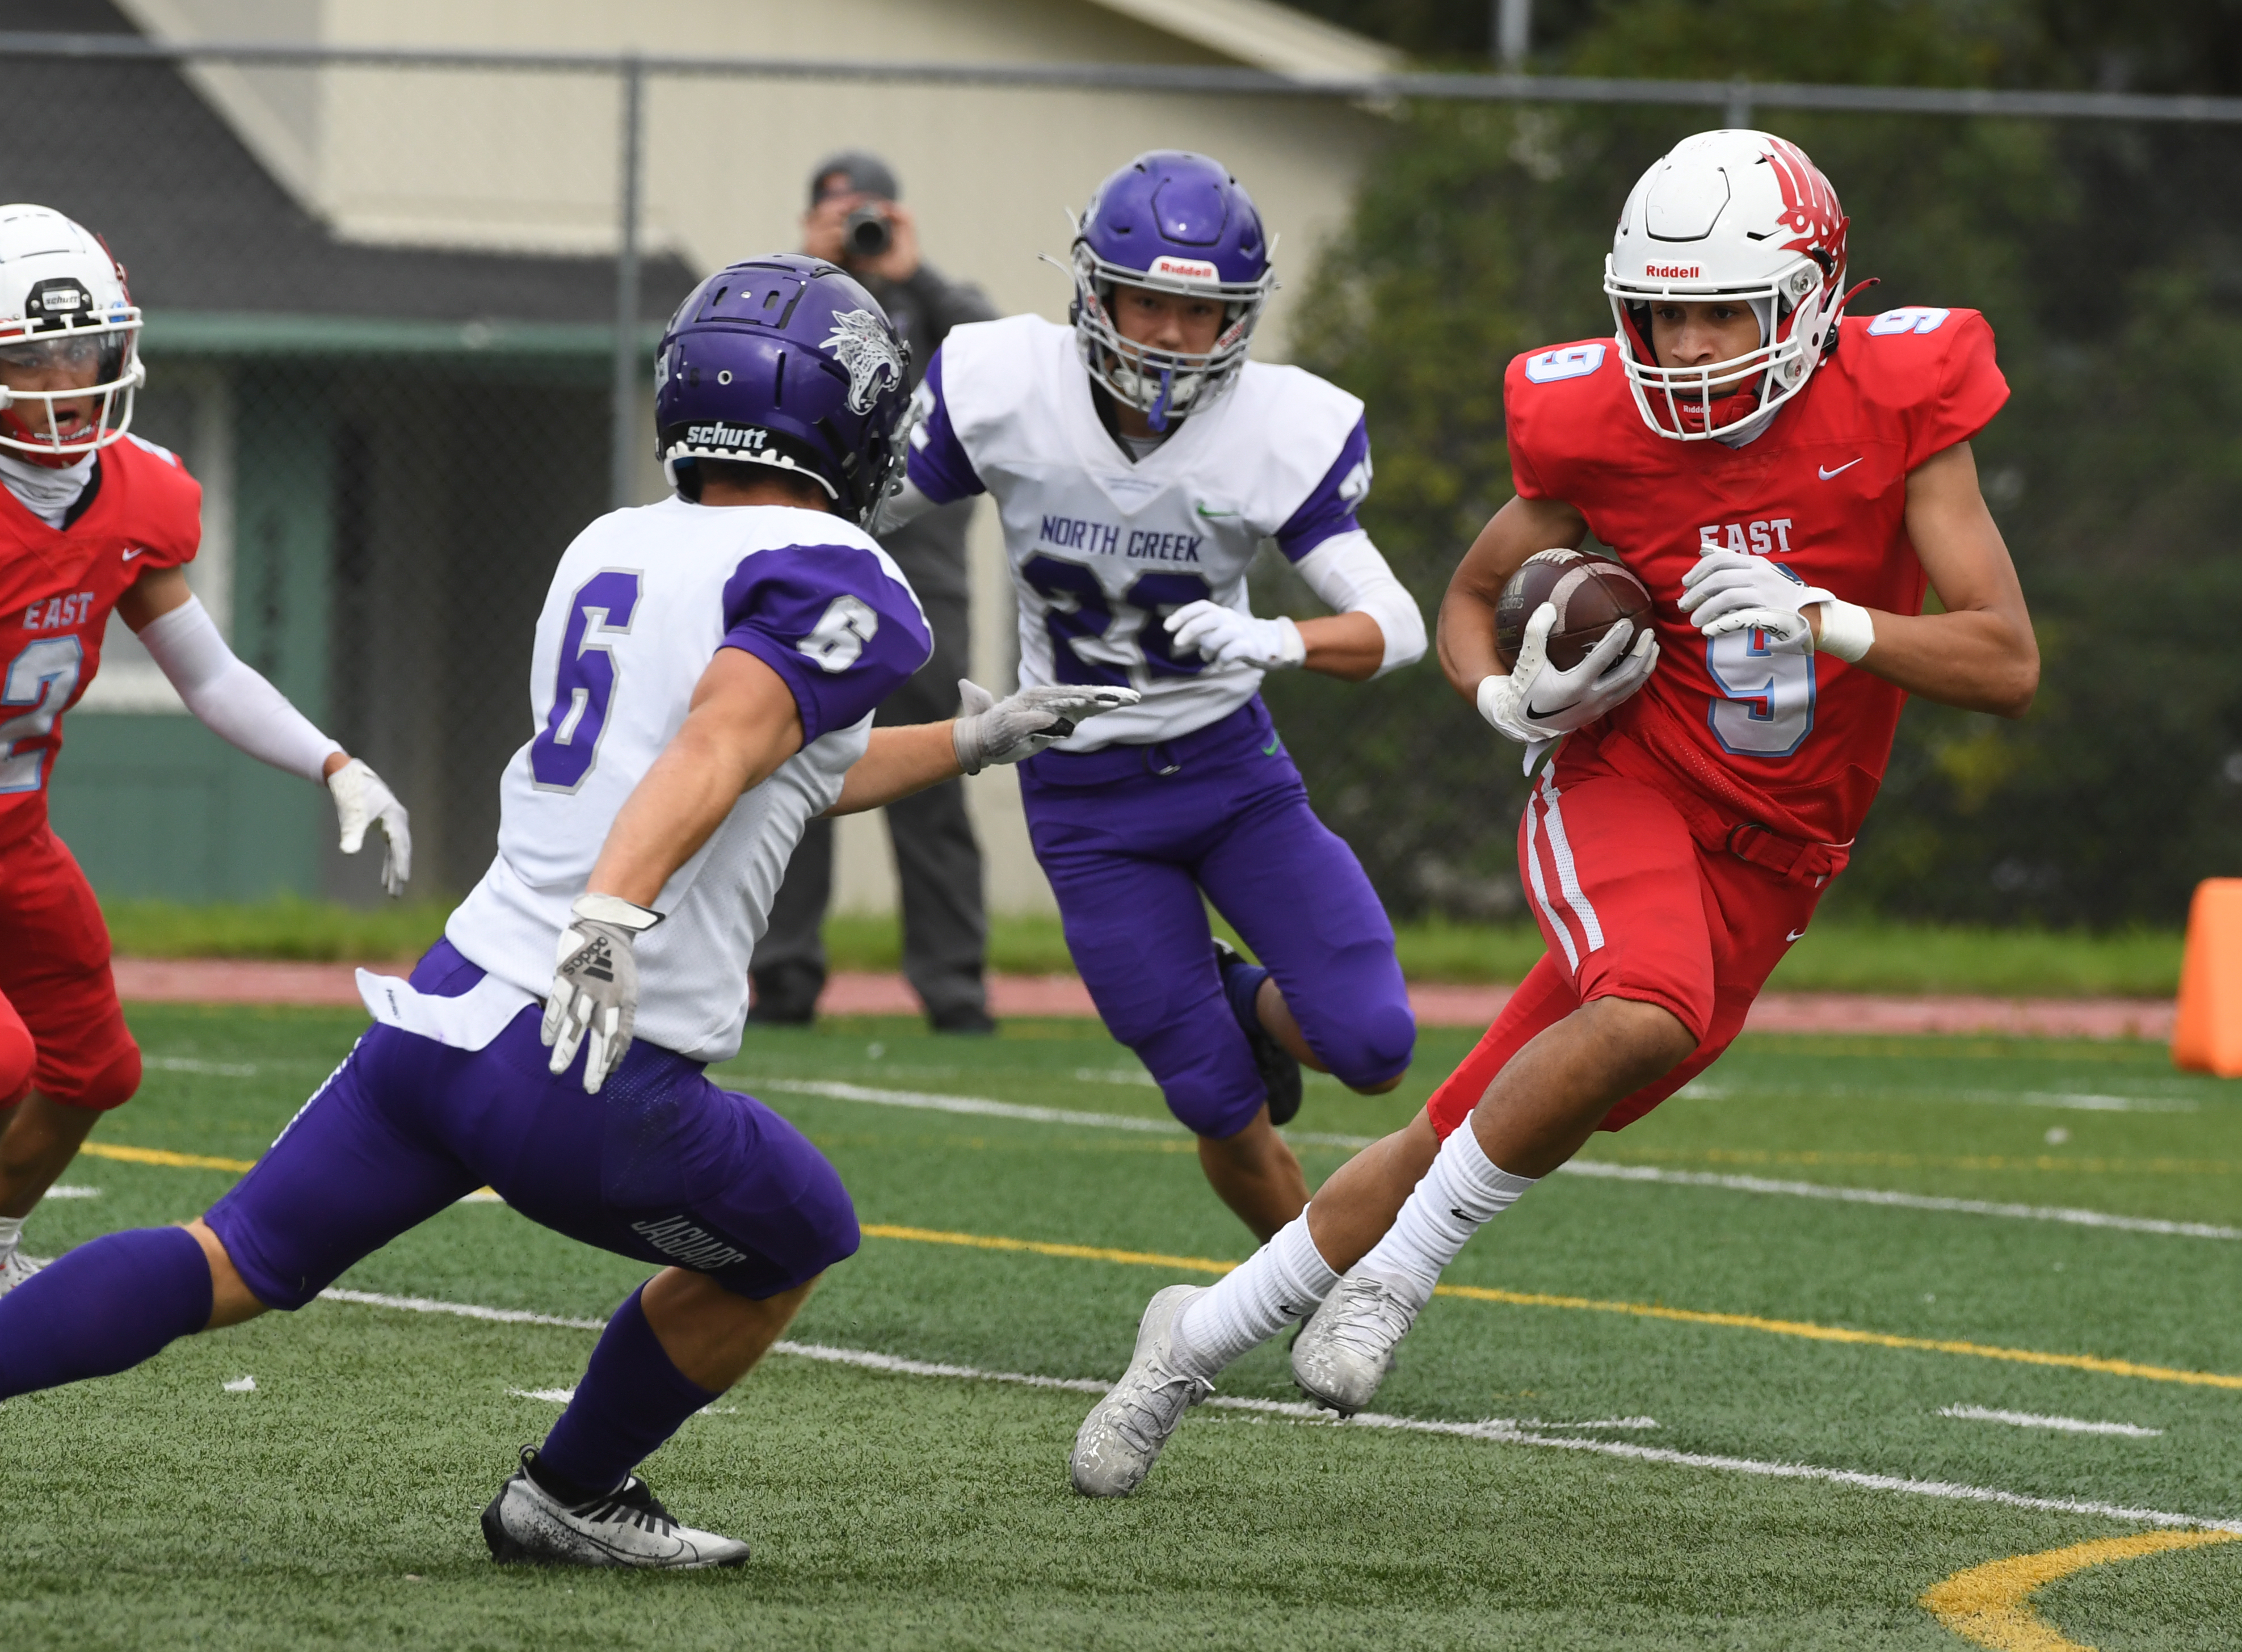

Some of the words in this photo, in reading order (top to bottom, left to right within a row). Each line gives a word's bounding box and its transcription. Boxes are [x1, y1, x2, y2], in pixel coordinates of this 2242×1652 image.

[1161, 263, 1212, 277] Riddell
[1646, 265, 1700, 278] Riddell
[45, 295, 79, 305] schutt
[1866, 307, 1950, 337] 9
[1525, 343, 1606, 384] 9
[687, 422, 768, 449] schutt
[1039, 515, 1120, 556] NORTH
[1127, 531, 1202, 562] CREEK
[1699, 518, 1793, 556] EAST
[22, 592, 94, 630] EAST
[797, 594, 878, 674] 6
[1706, 562, 1816, 758] 9
[528, 566, 644, 795] 6
[563, 936, 608, 976] adidas
[631, 1214, 747, 1270] JAGUARS
